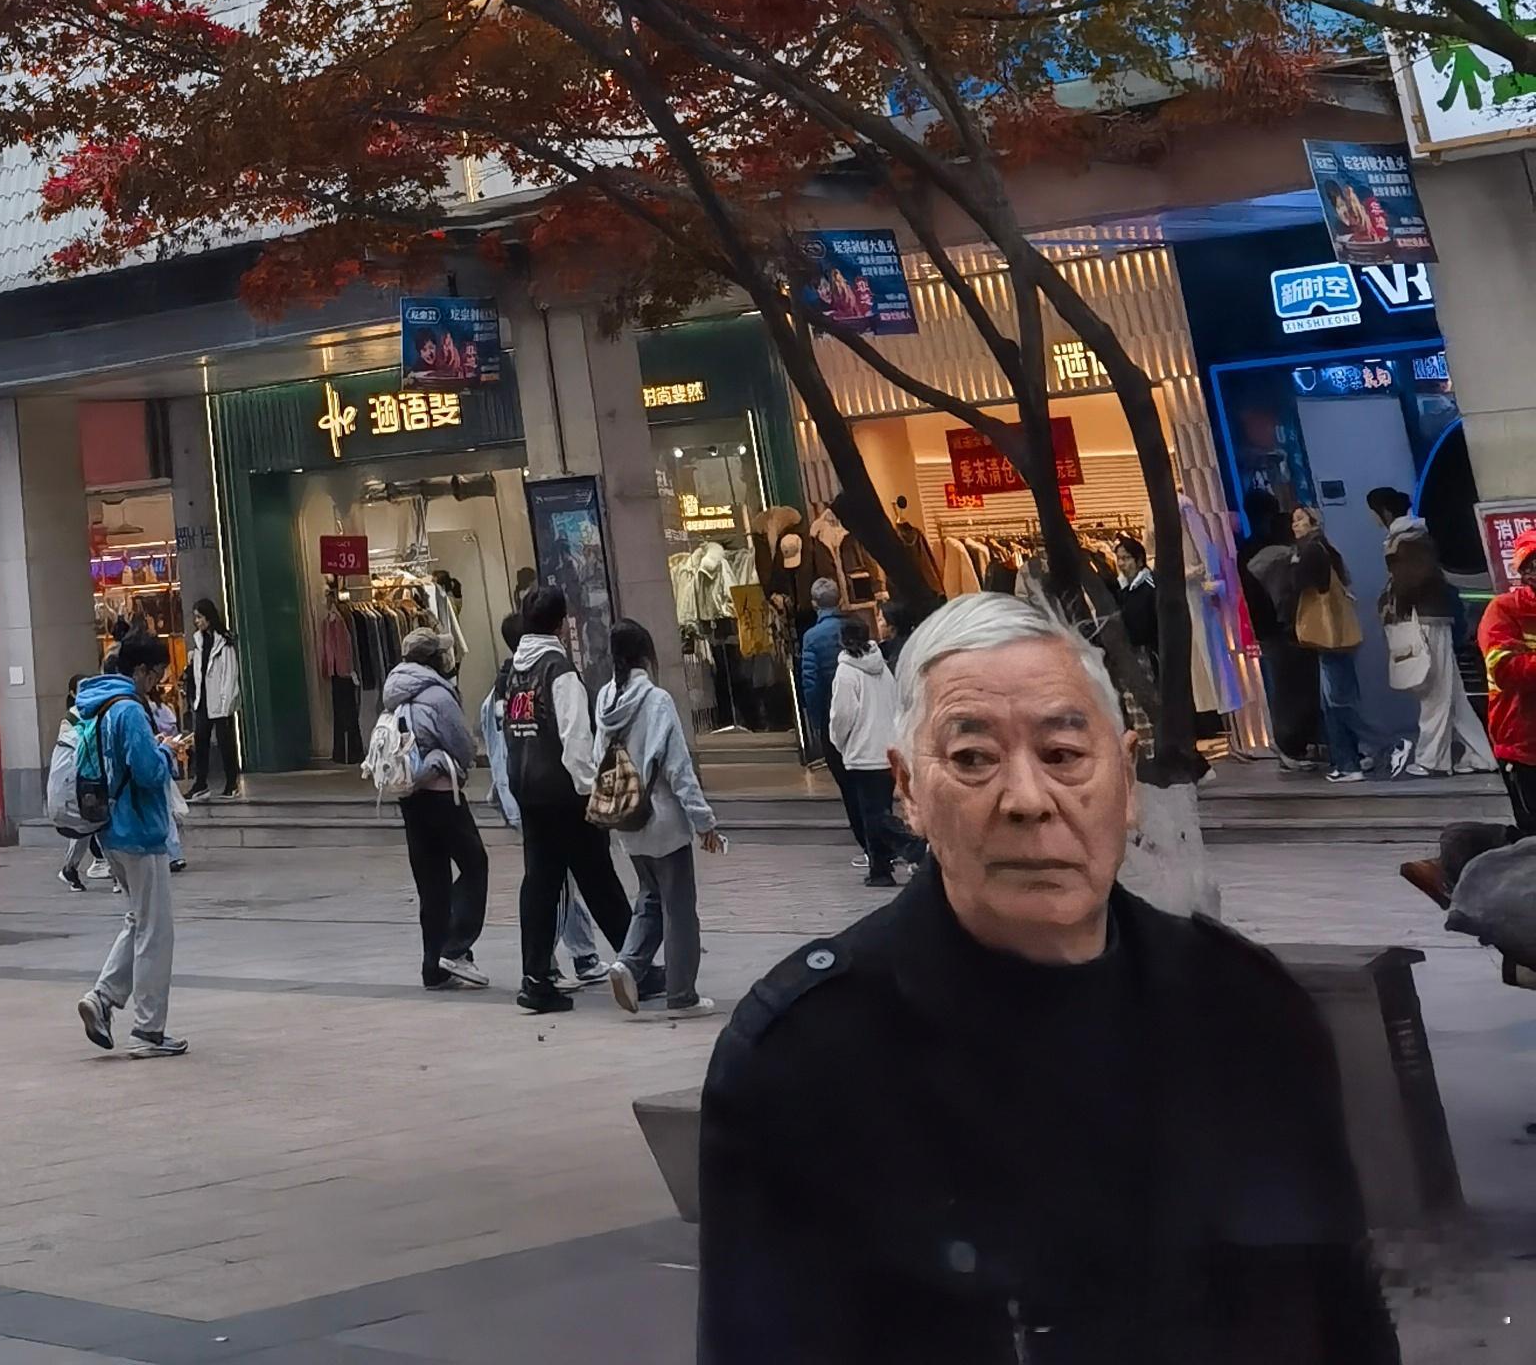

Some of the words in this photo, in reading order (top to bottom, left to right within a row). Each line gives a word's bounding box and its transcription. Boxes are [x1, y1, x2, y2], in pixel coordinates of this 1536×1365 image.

[1280, 275, 1351, 308] 新时空
[1494, 517, 1536, 541] 消防
